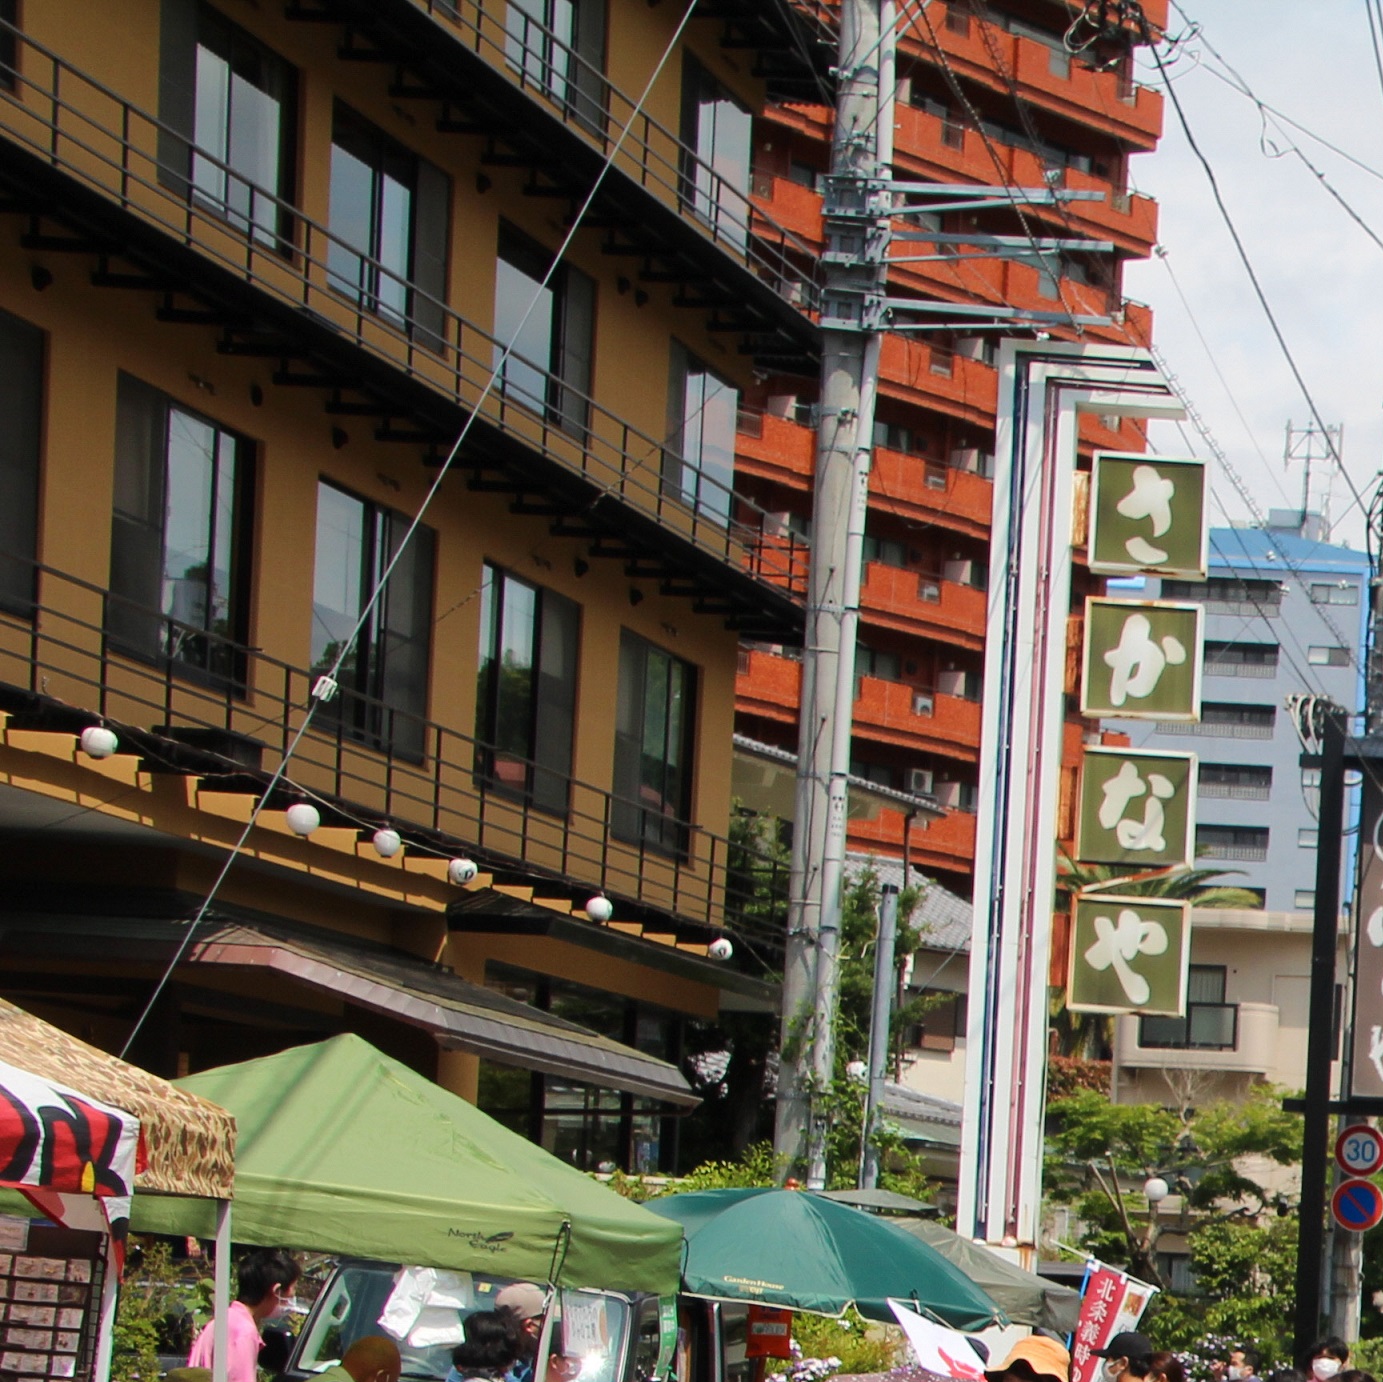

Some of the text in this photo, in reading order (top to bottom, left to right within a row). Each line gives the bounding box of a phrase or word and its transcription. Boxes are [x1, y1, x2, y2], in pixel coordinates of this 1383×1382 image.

[1084, 464, 1187, 1006] さかなや
[1346, 1139, 1376, 1163] 30
[447, 1227, 486, 1241] North
[1072, 1277, 1117, 1382] 北条義時の
